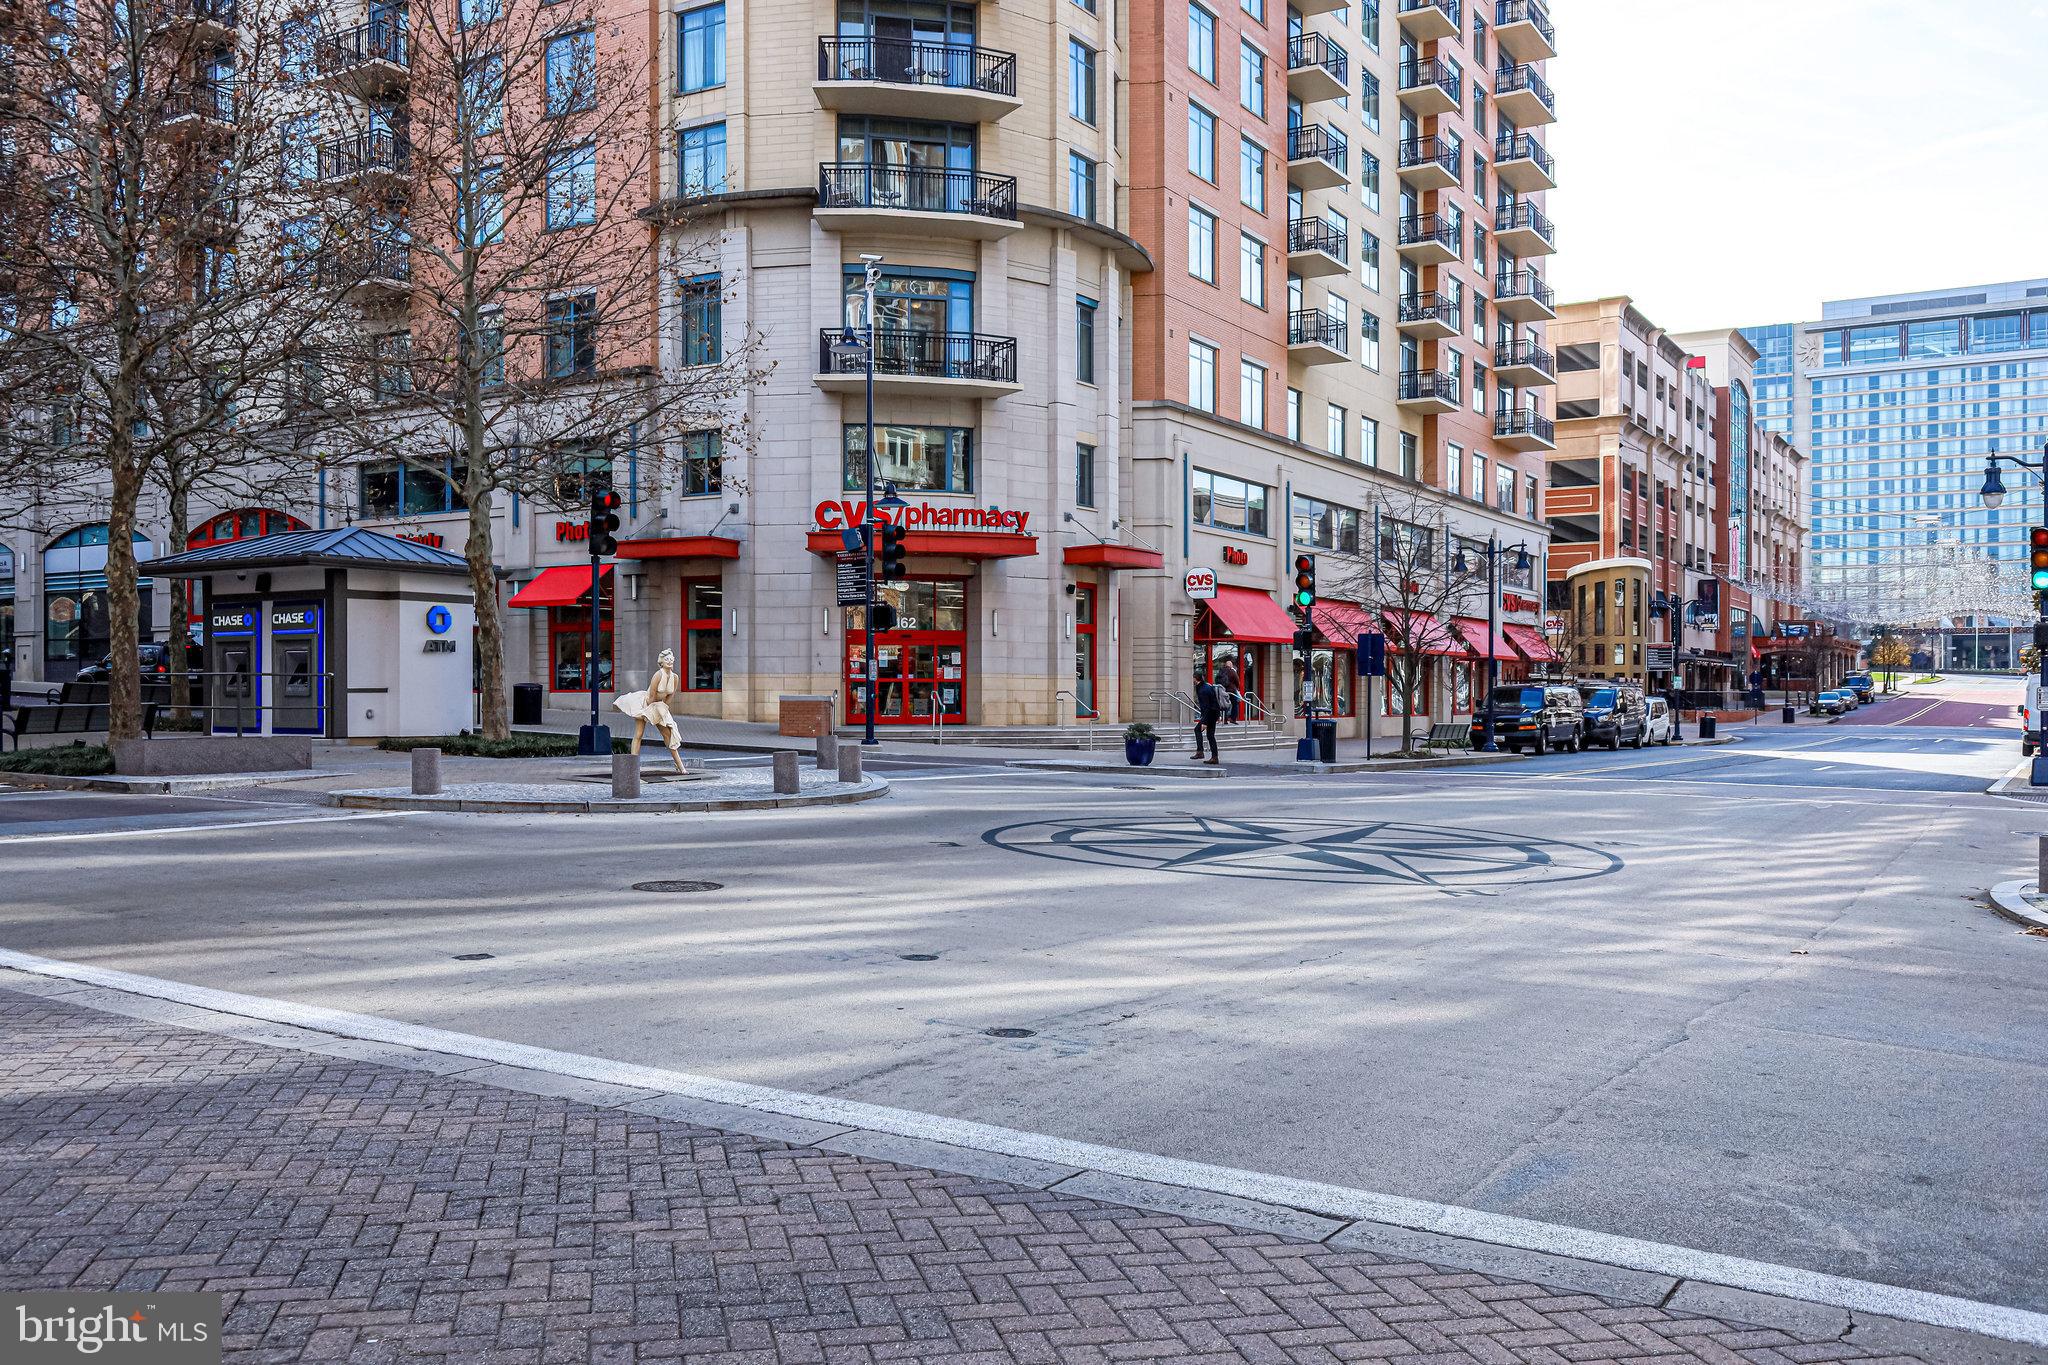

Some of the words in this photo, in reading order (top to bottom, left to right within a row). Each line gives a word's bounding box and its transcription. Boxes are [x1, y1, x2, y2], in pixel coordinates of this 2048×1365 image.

[1188, 574, 1213, 586] CVS
[212, 615, 243, 626] CHASE
[272, 613, 304, 624] CHASE
[423, 640, 456, 653] ATM
